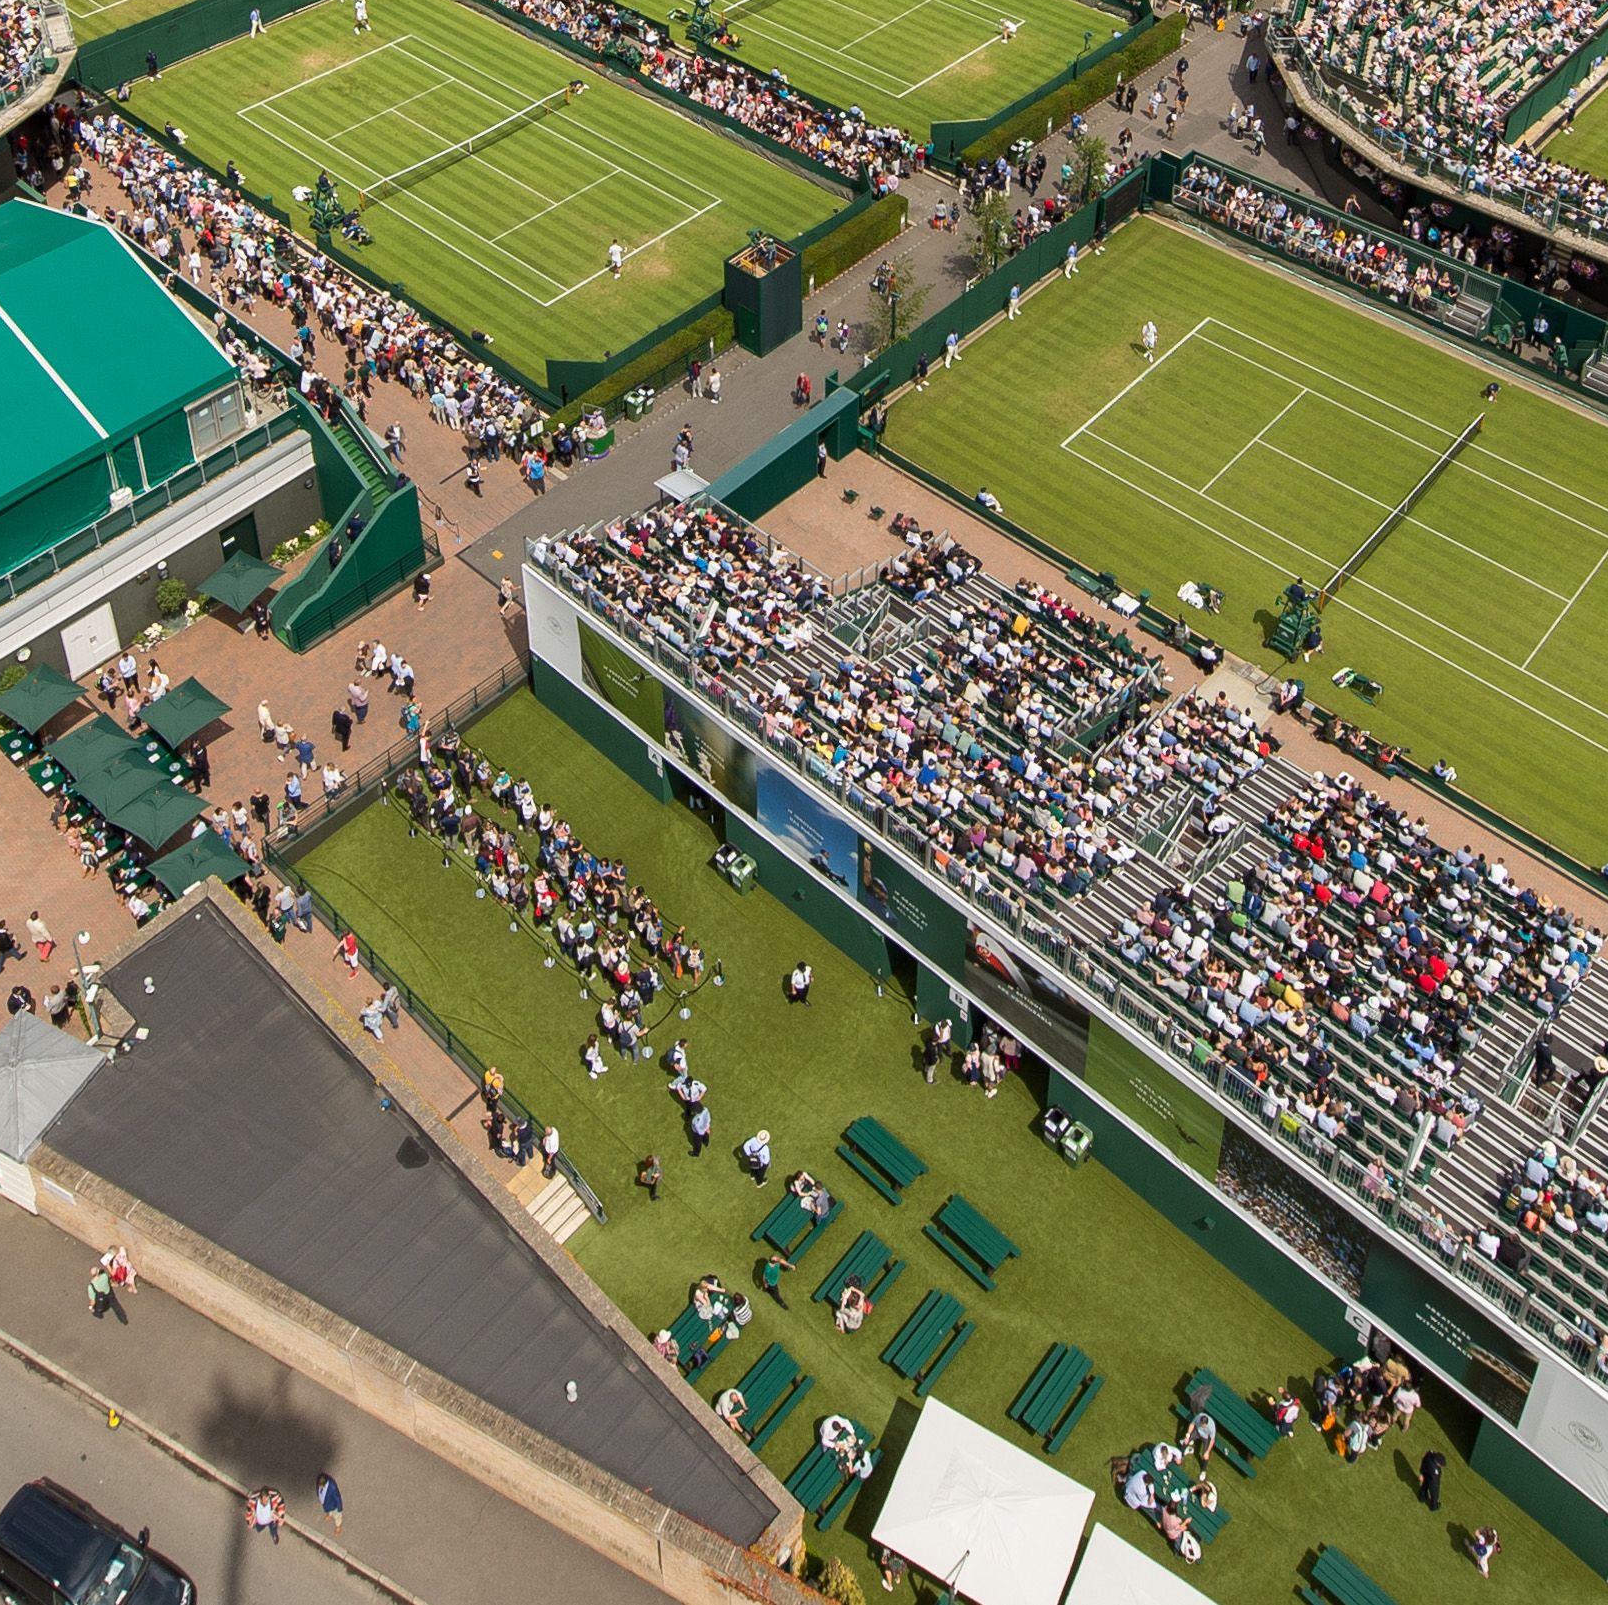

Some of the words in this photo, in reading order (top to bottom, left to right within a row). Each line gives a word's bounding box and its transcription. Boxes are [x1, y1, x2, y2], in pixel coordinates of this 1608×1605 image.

[1415, 1312, 1444, 1338] WITHIN
[1446, 1336, 1473, 1361] REACH
[1425, 1303, 1471, 1341] GREATNESS
[1430, 1315, 1449, 1333] WILL
